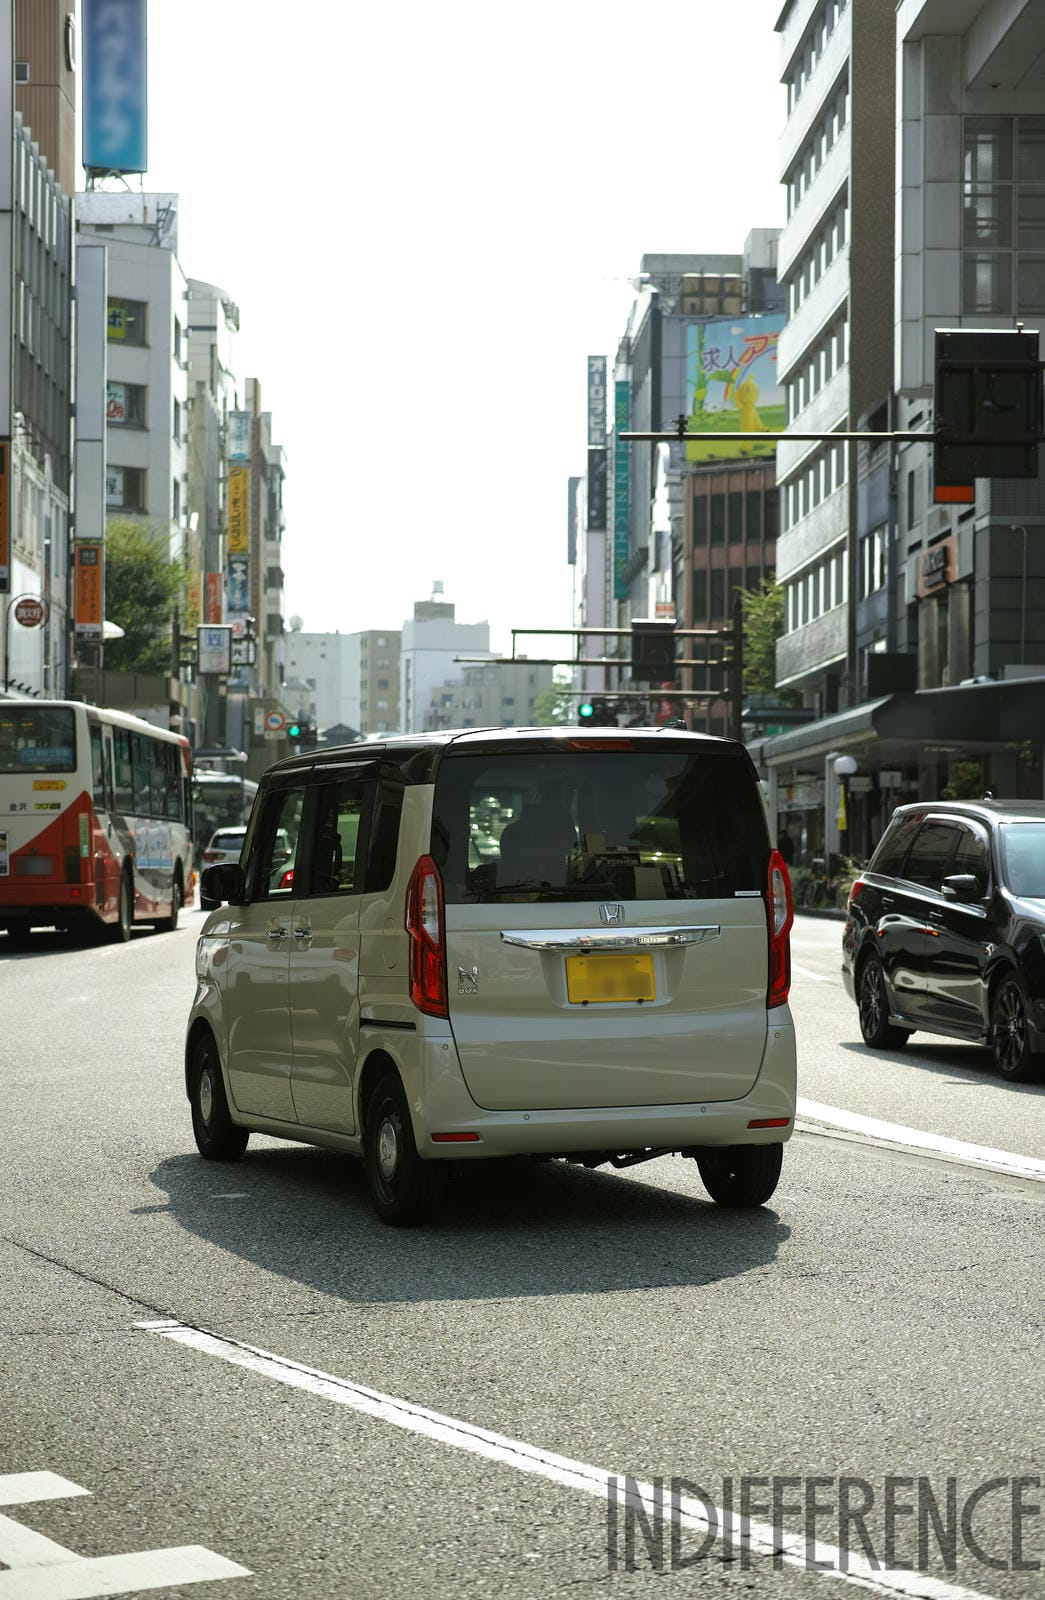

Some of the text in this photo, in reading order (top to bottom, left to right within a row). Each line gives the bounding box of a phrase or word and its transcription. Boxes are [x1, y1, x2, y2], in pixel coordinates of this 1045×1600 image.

[589, 358, 605, 444] オーロラビル
